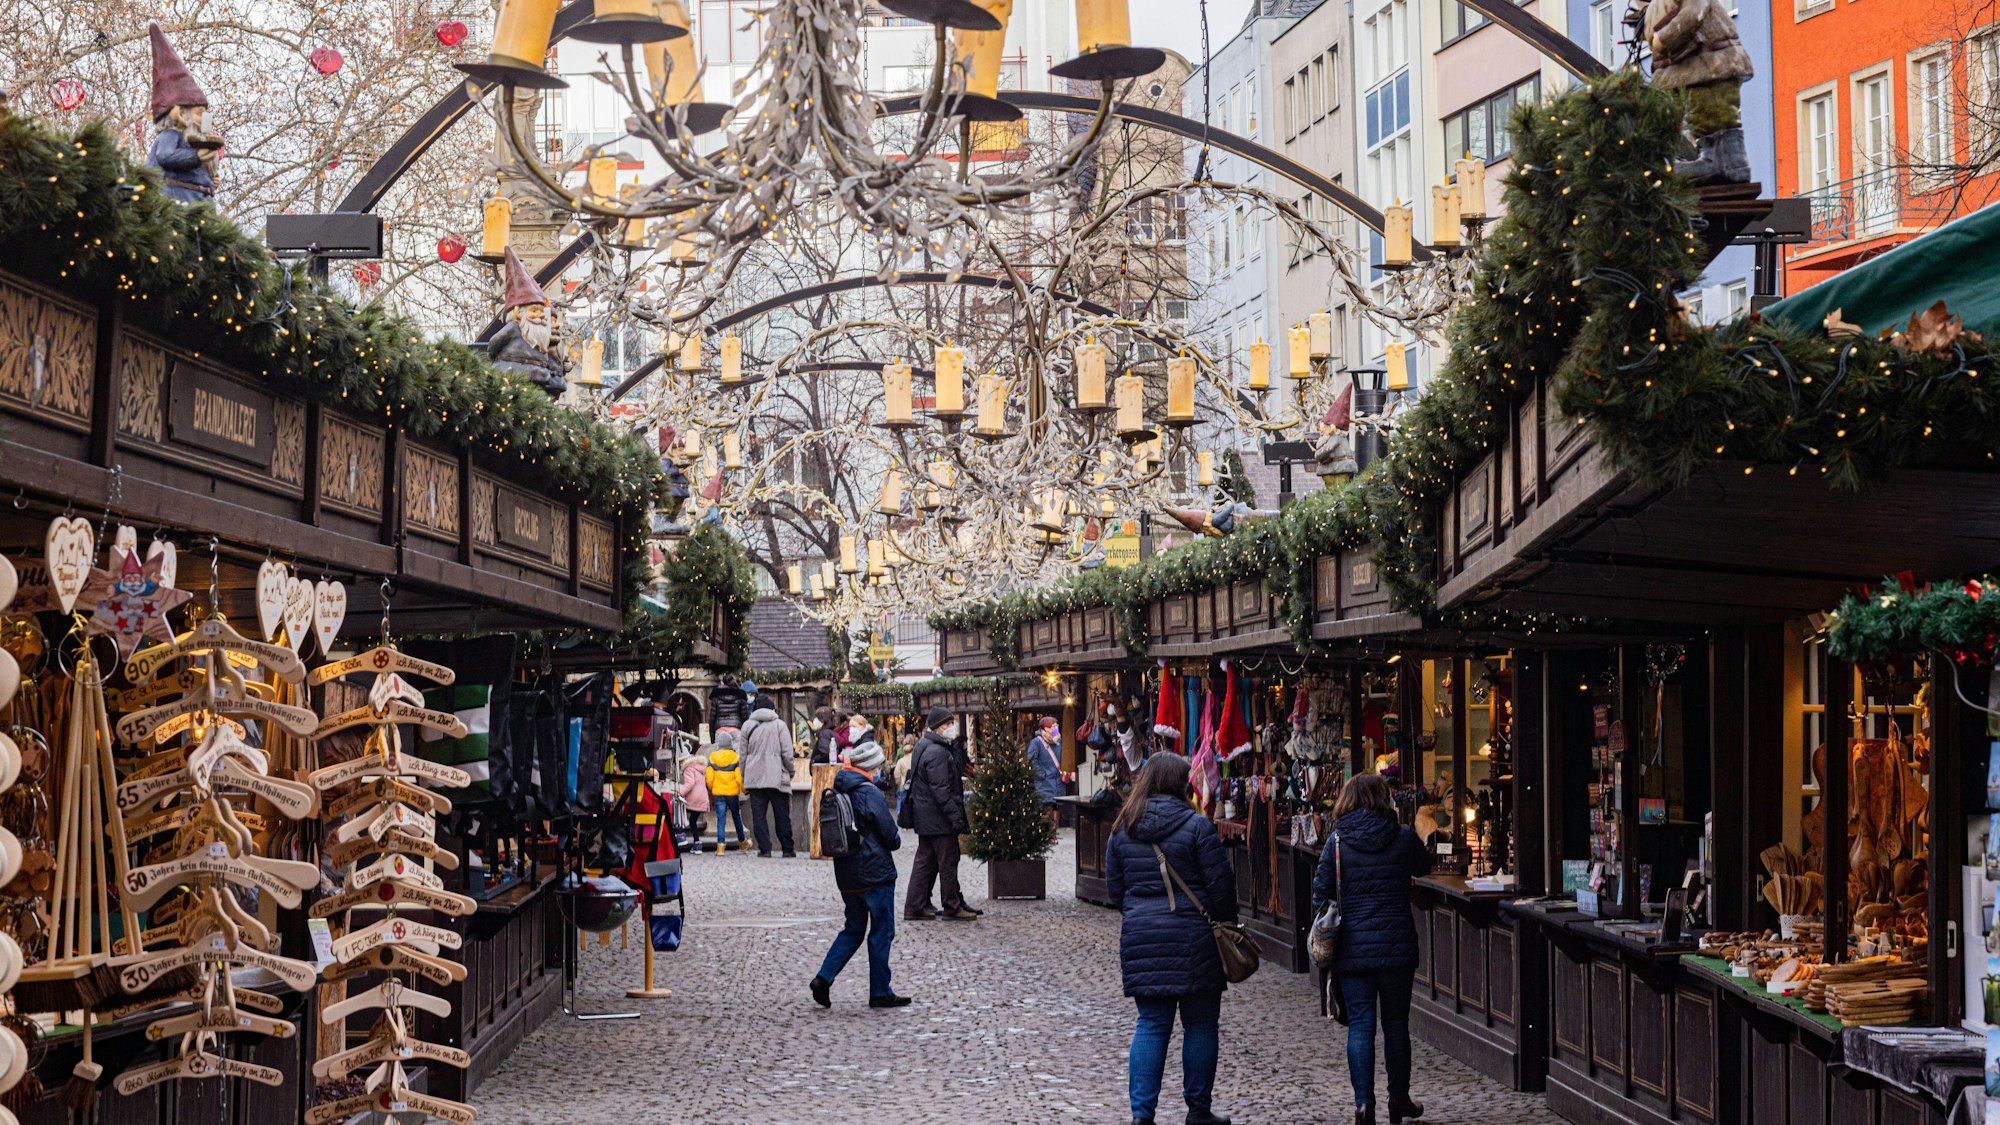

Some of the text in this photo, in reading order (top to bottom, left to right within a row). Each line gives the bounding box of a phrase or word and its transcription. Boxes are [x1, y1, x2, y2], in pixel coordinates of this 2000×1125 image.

[194, 387, 257, 448] BRANDMALEREI
[128, 658, 150, 682] 90
[150, 649, 174, 665] Jahre
[197, 638, 226, 649] Grund
[226, 640, 243, 649] zum
[244, 640, 288, 665] Aufhängen!
[324, 664, 338, 677] FC
[340, 658, 362, 671] Köln
[395, 655, 407, 668] ich
[407, 659, 424, 675] häng
[425, 666, 434, 675] an
[434, 667, 452, 682] Dir!
[122, 718, 148, 740] 75
[147, 708, 175, 726] Jahre
[234, 701, 253, 709] zum
[255, 702, 306, 726] Aufhängen!
[396, 704, 408, 717] ich
[409, 708, 426, 722] häng
[427, 714, 436, 722] an
[436, 714, 455, 728] Dir!
[318, 773, 339, 786] Bayer
[408, 759, 420, 770] ich
[421, 762, 438, 778] häng
[440, 769, 449, 778] an
[450, 770, 468, 784] Dir!
[116, 786, 140, 808] 65
[144, 778, 171, 794] Jahre
[231, 776, 249, 786] zum
[252, 779, 300, 809] Aufhängen!
[126, 861, 292, 898] 50 Jahre kein Grund zum Aufhängen!
[402, 887, 414, 900] ich
[415, 890, 432, 906] häng
[433, 899, 442, 907] an
[443, 898, 462, 913] Dir!
[411, 925, 421, 937] ich
[422, 928, 436, 942] häng
[445, 932, 460, 946] Dir!
[123, 951, 306, 990] 30 Jahre kein Grund zum Aufhängen!
[399, 953, 409, 966] ich
[410, 958, 424, 972] häng
[433, 968, 449, 984] Dir!
[260, 994, 280, 1009] Dir!
[413, 1041, 424, 1053] ich
[442, 1051, 451, 1059] an
[451, 1051, 469, 1065] Dir!
[248, 1069, 258, 1077] an
[259, 1068, 279, 1083] Dir!
[313, 1107, 331, 1122] FC
[406, 1096, 418, 1109] ich
[419, 1100, 438, 1116] häng
[440, 1109, 449, 1117] an
[450, 1109, 470, 1125] Dir!
